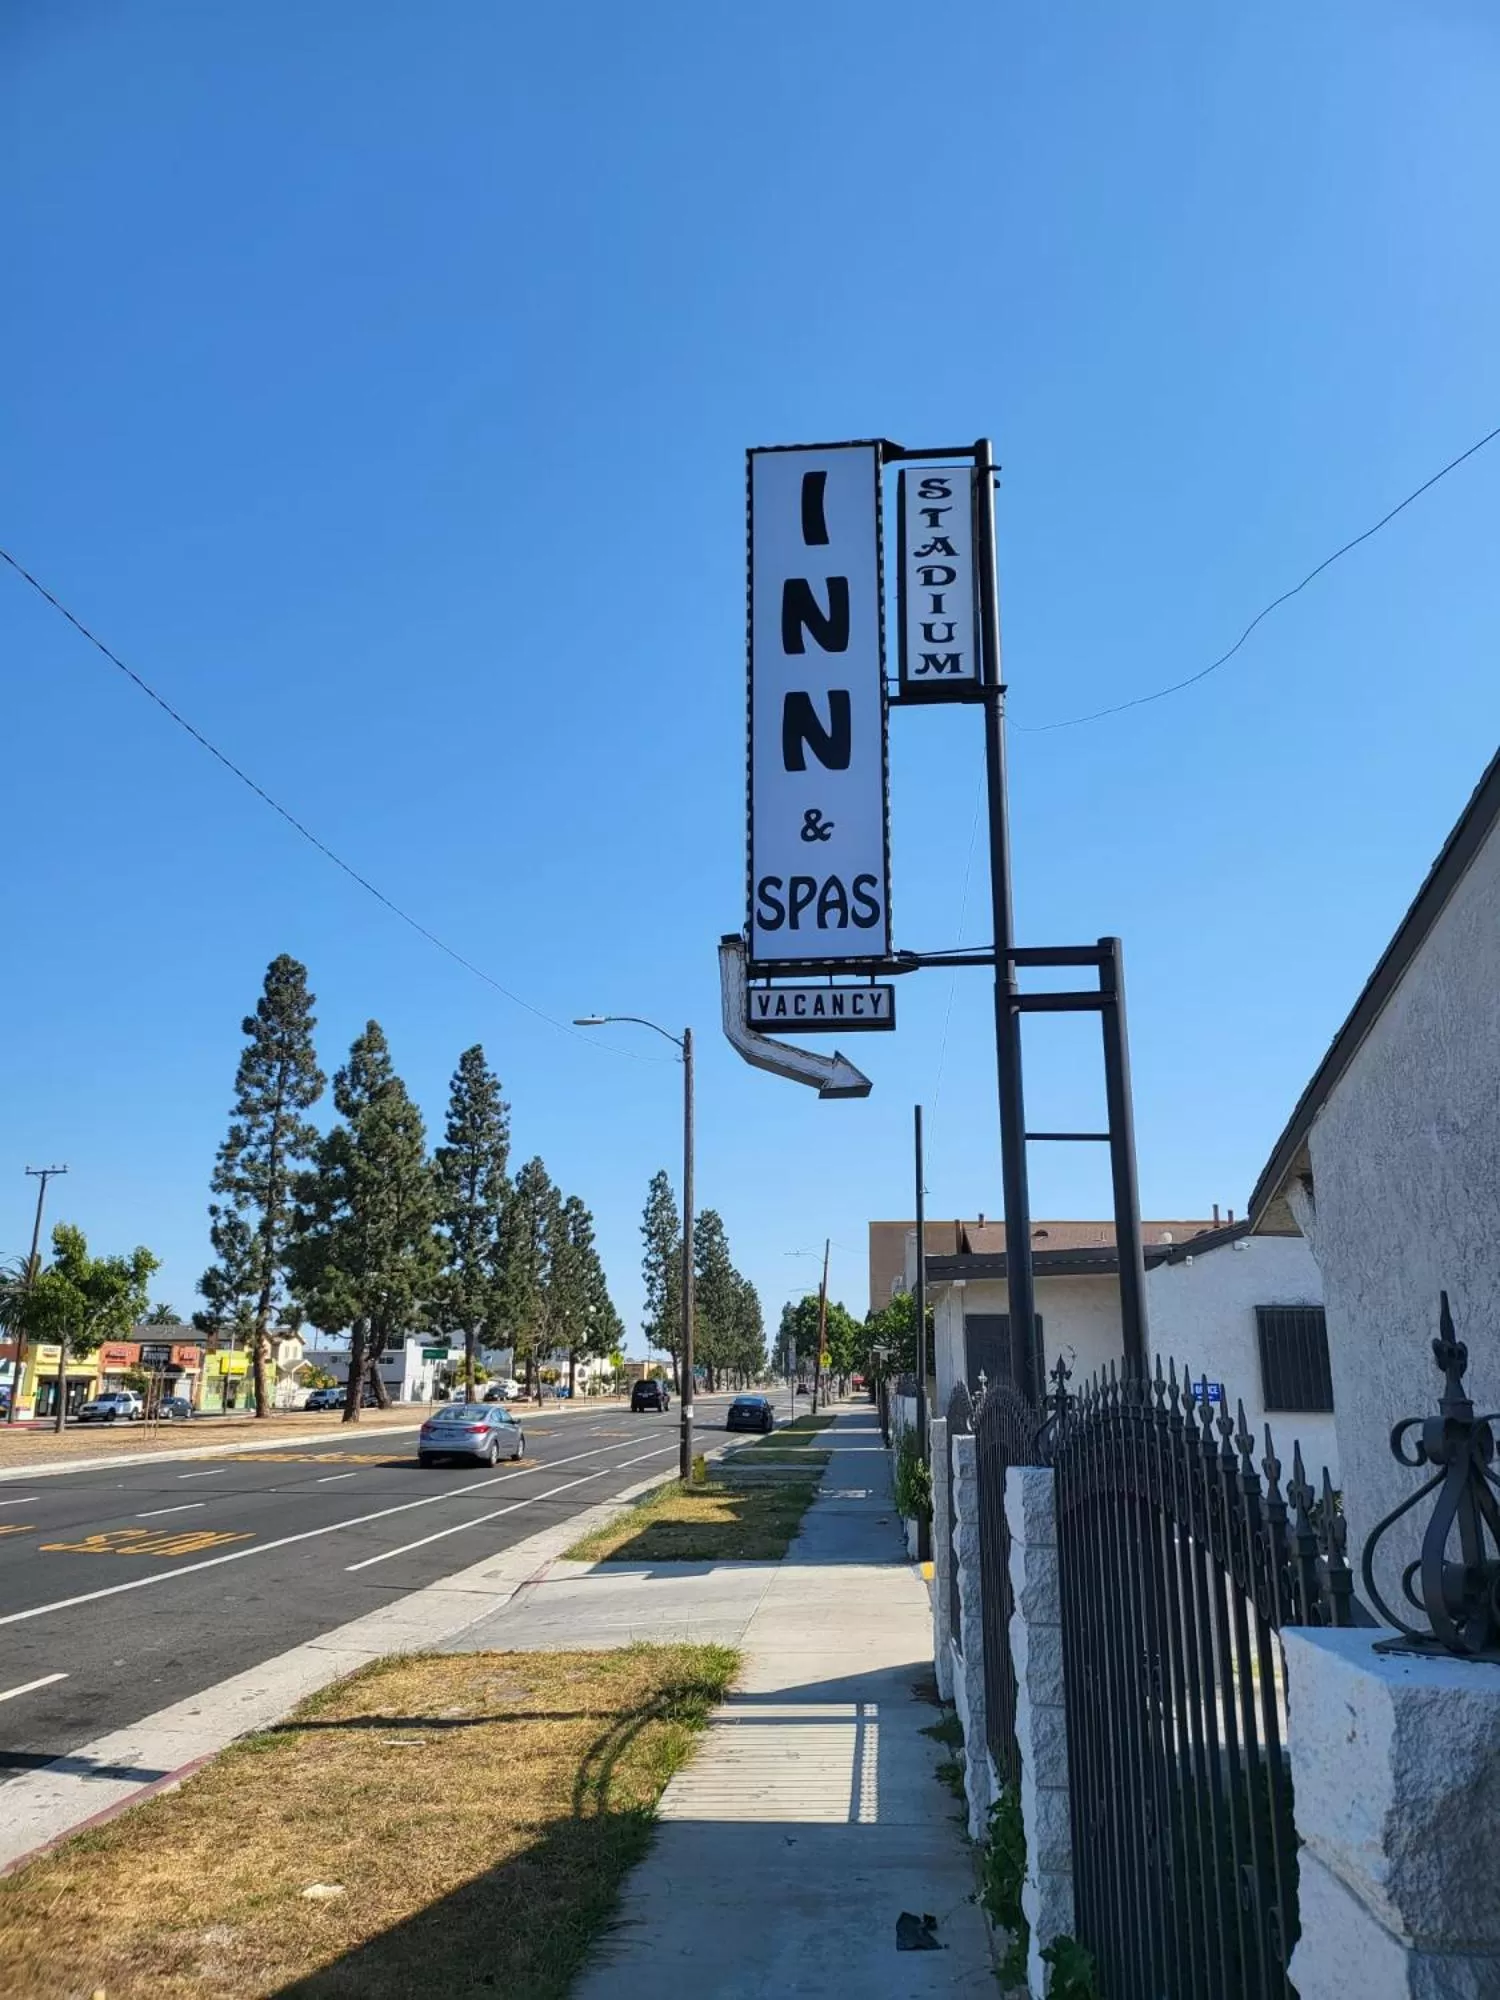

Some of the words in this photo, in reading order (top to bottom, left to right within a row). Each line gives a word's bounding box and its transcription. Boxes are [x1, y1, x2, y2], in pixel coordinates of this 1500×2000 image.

[913, 478, 964, 674] STADIUM
[781, 471, 852, 771] INN
[800, 808, 834, 842] &
[756, 874, 881, 931] SPAS
[758, 993, 883, 1017] VACANCY
